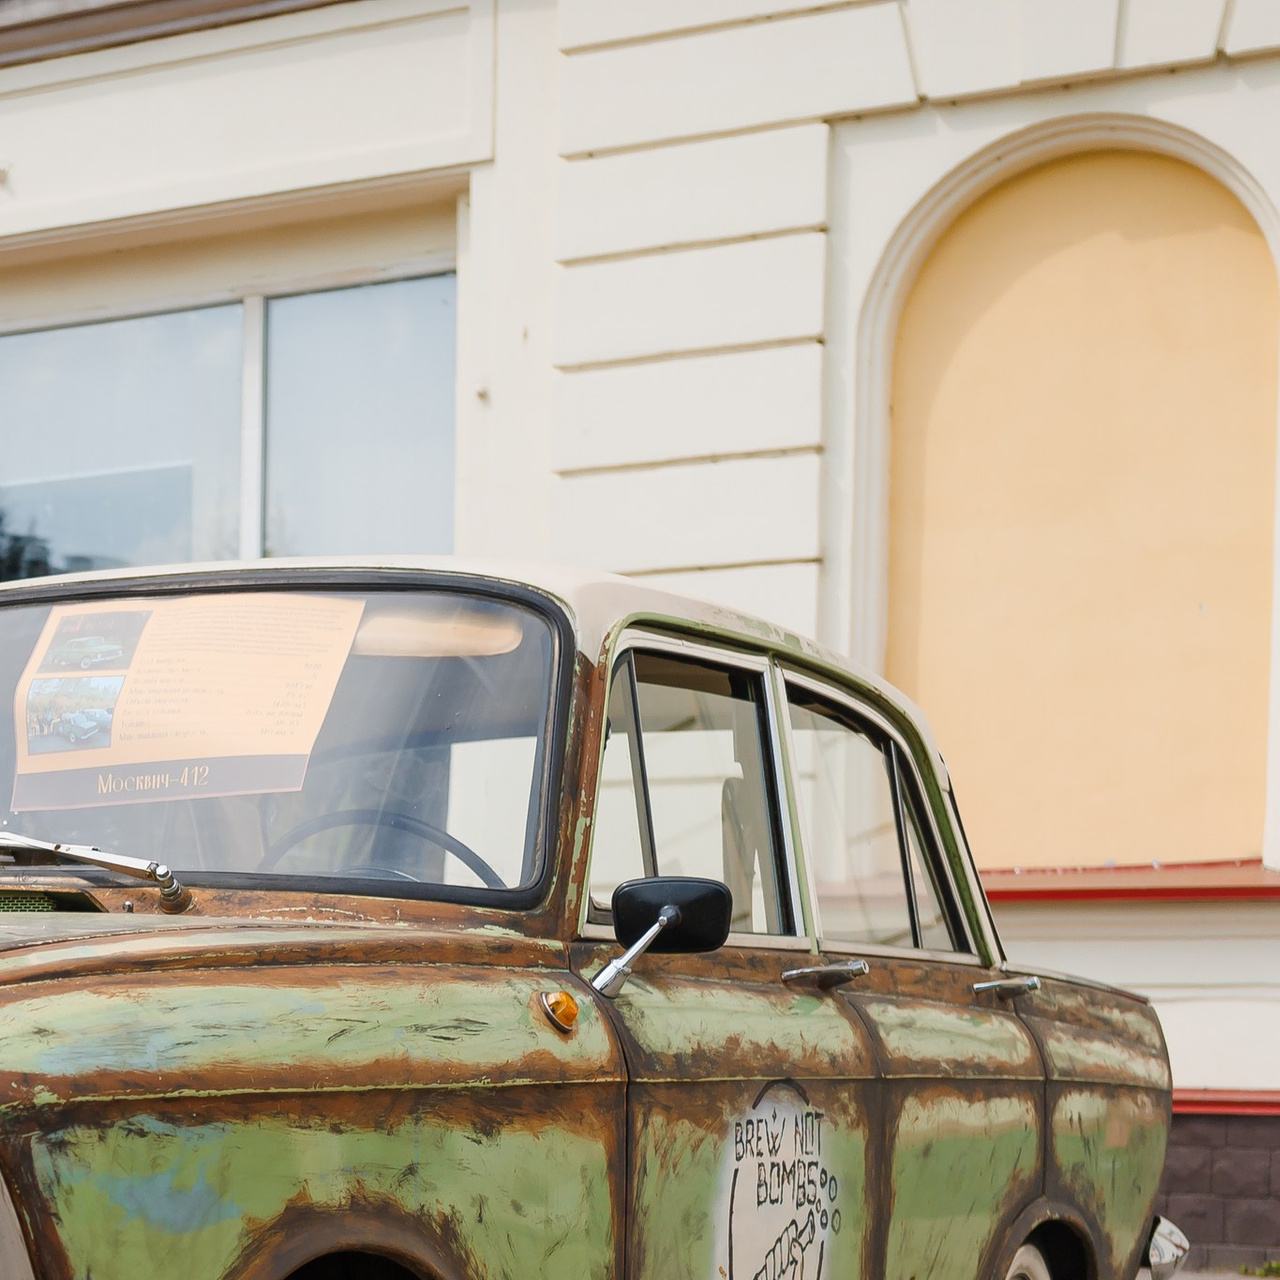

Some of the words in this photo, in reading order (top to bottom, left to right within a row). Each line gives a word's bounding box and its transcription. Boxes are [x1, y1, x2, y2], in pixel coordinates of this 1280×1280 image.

[734, 1115, 786, 1162] BREW
[794, 1112, 825, 1157] NOT
[756, 1159, 819, 1210] BOMBS
